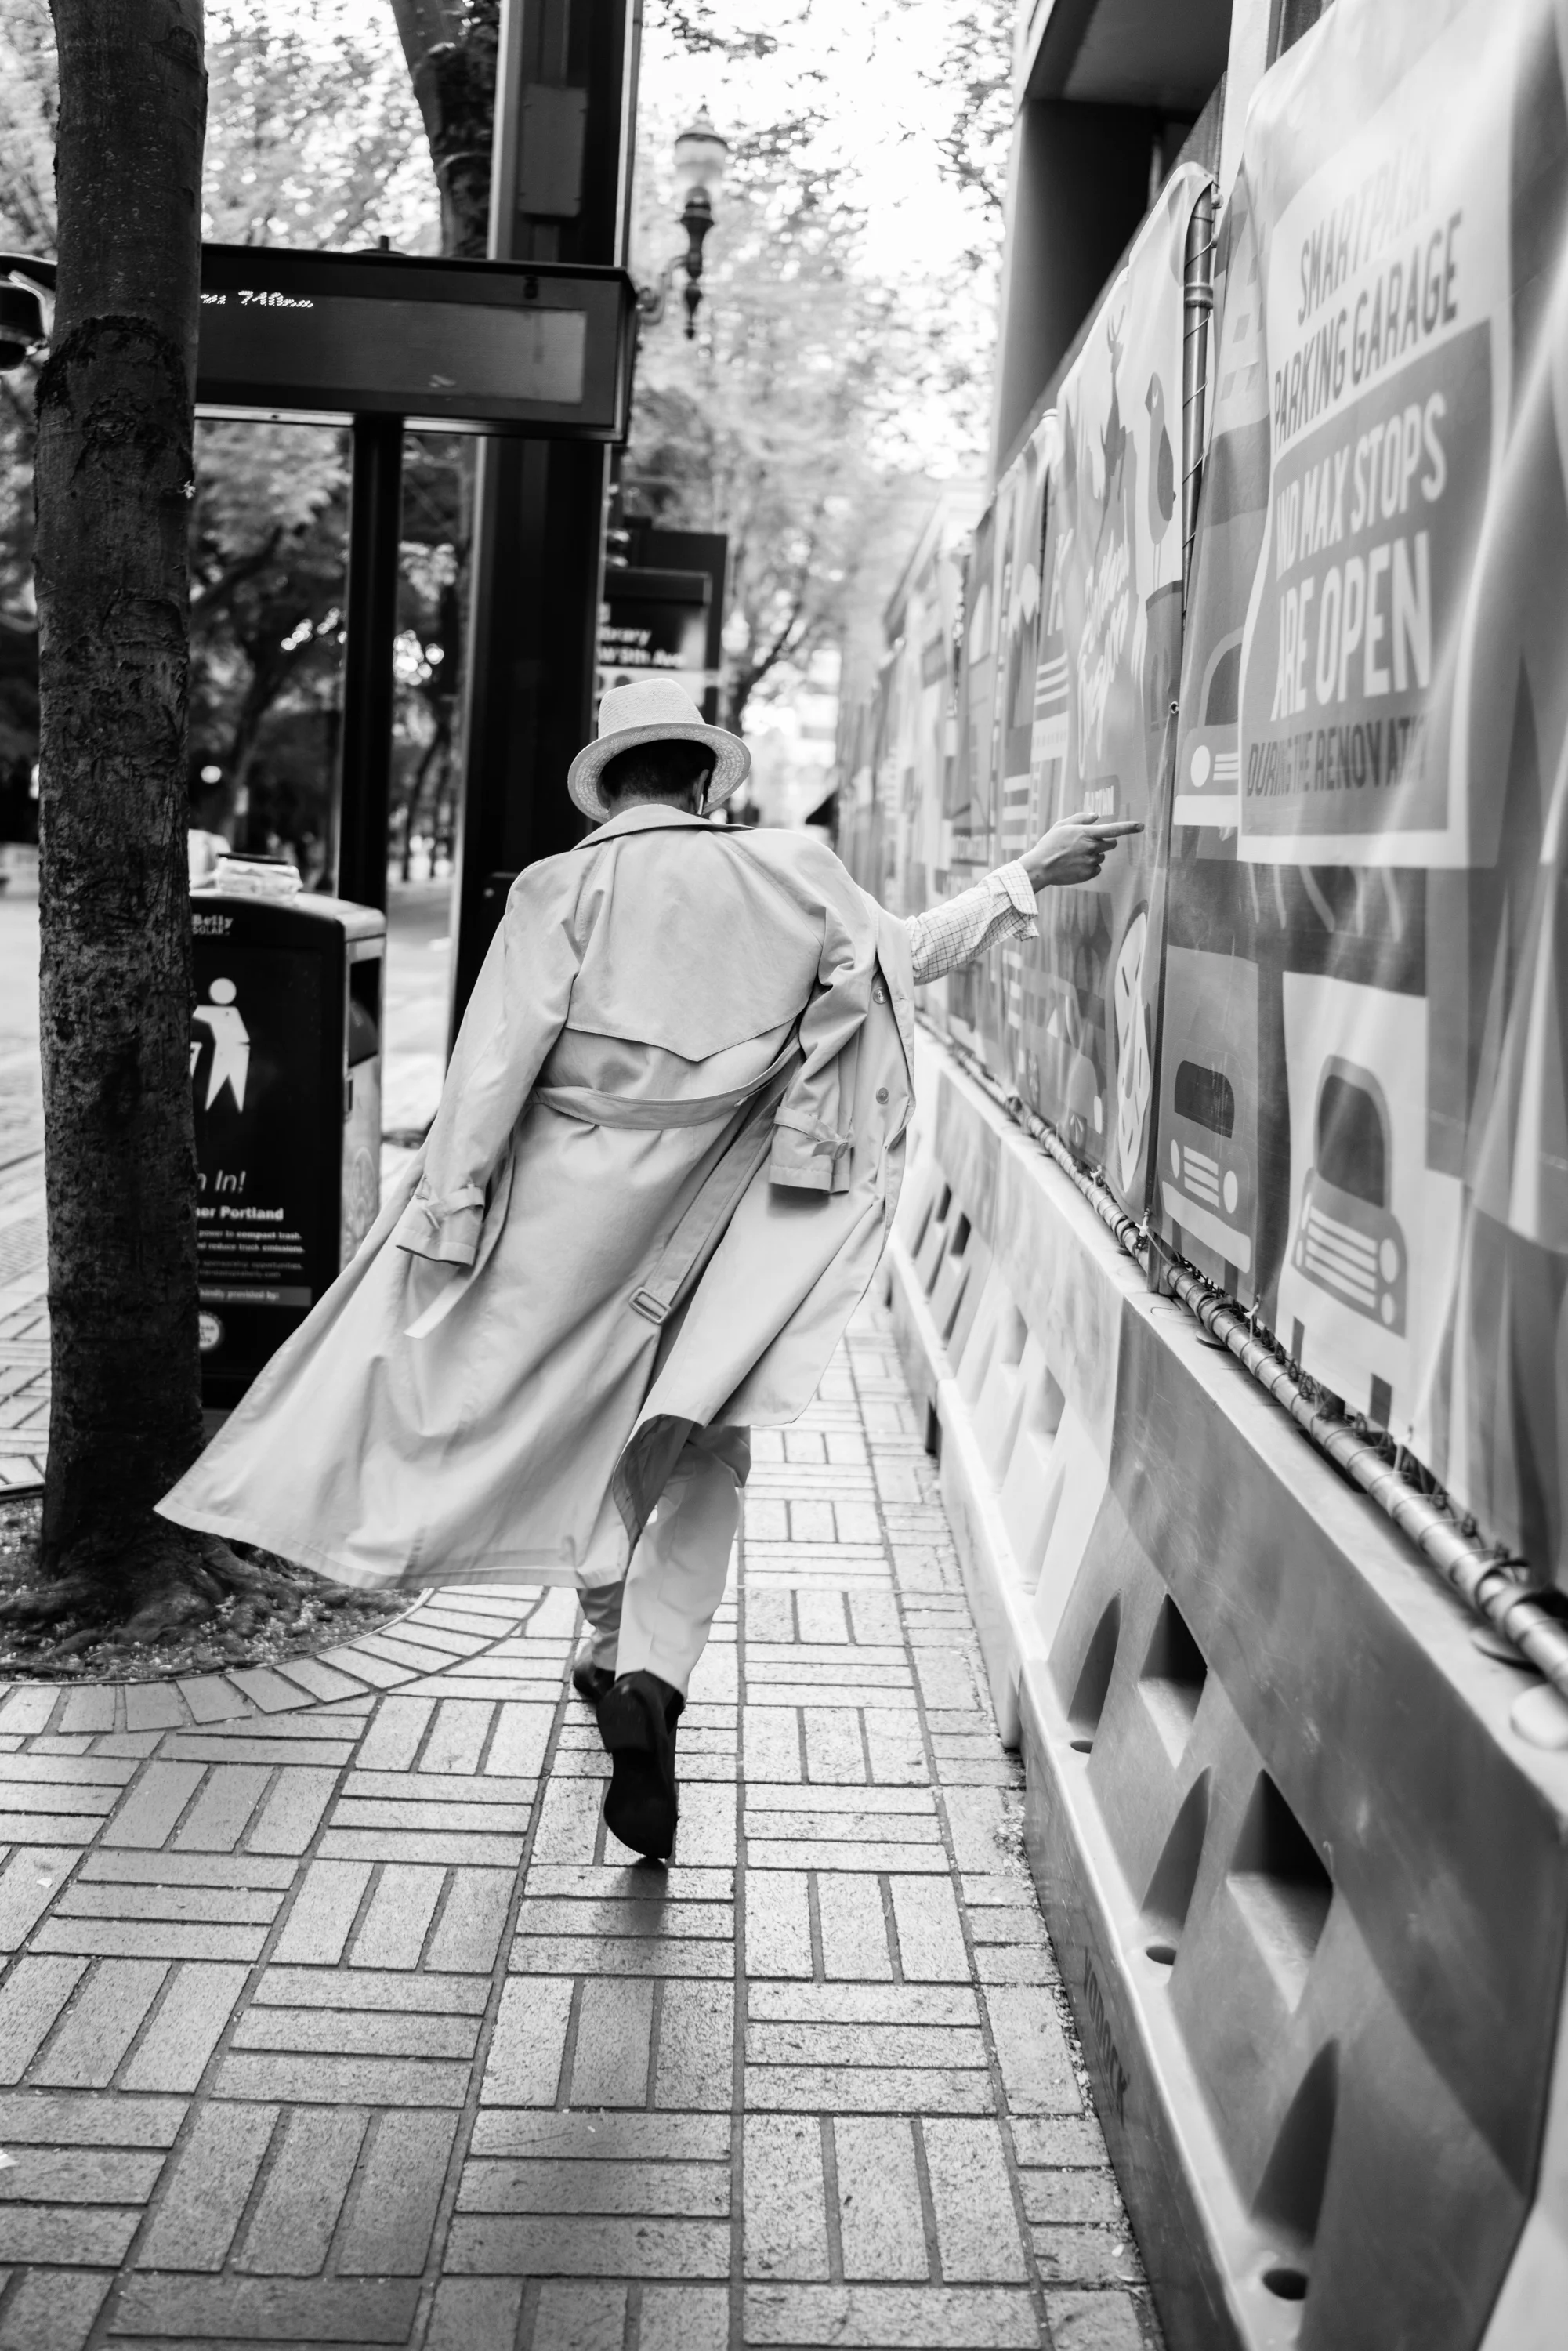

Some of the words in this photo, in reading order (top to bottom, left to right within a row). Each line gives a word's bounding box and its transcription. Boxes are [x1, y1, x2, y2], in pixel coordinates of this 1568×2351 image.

[1273, 306, 1348, 455] PARKING
[1351, 205, 1465, 386] GARAGE
[1299, 444, 1349, 561] MAX
[1350, 391, 1448, 534] STOPS
[1269, 575, 1315, 721] ARE
[1316, 530, 1430, 705] OPEN
[215, 1169, 247, 1194] In!
[220, 1205, 284, 1222] Portland
[198, 1230, 223, 1240] power
[225, 1230, 235, 1239] to
[236, 1231, 276, 1241] compact
[208, 1242, 237, 1252] reduce
[238, 1243, 260, 1253] truck
